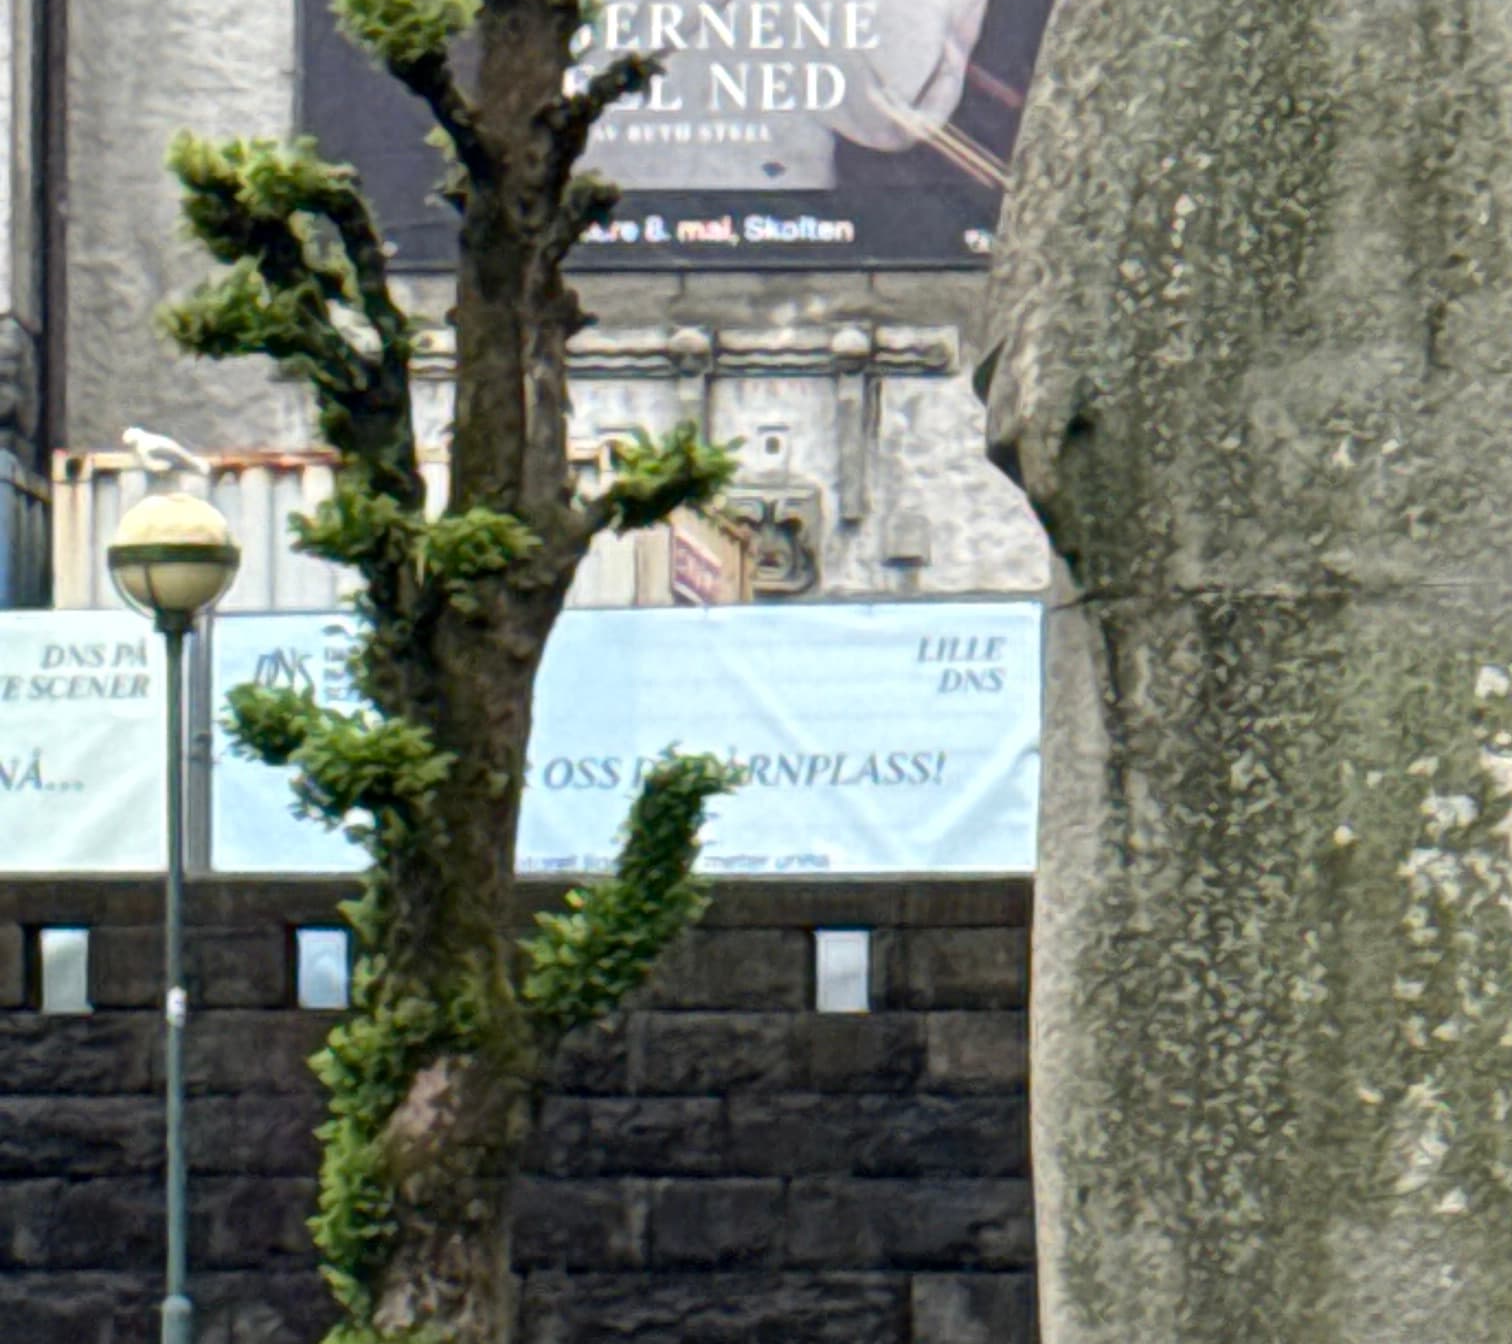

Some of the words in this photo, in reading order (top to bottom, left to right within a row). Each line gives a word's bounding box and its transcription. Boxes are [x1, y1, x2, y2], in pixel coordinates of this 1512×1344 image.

[709, 60, 848, 112] NED
[744, 214, 855, 243] Skolten
[40, 643, 105, 670] DNS
[111, 635, 148, 668] PÅ
[917, 635, 1008, 663] LILLE
[28, 673, 151, 701] SCENER
[937, 666, 1008, 694] DNS
[543, 756, 621, 790] OSS
